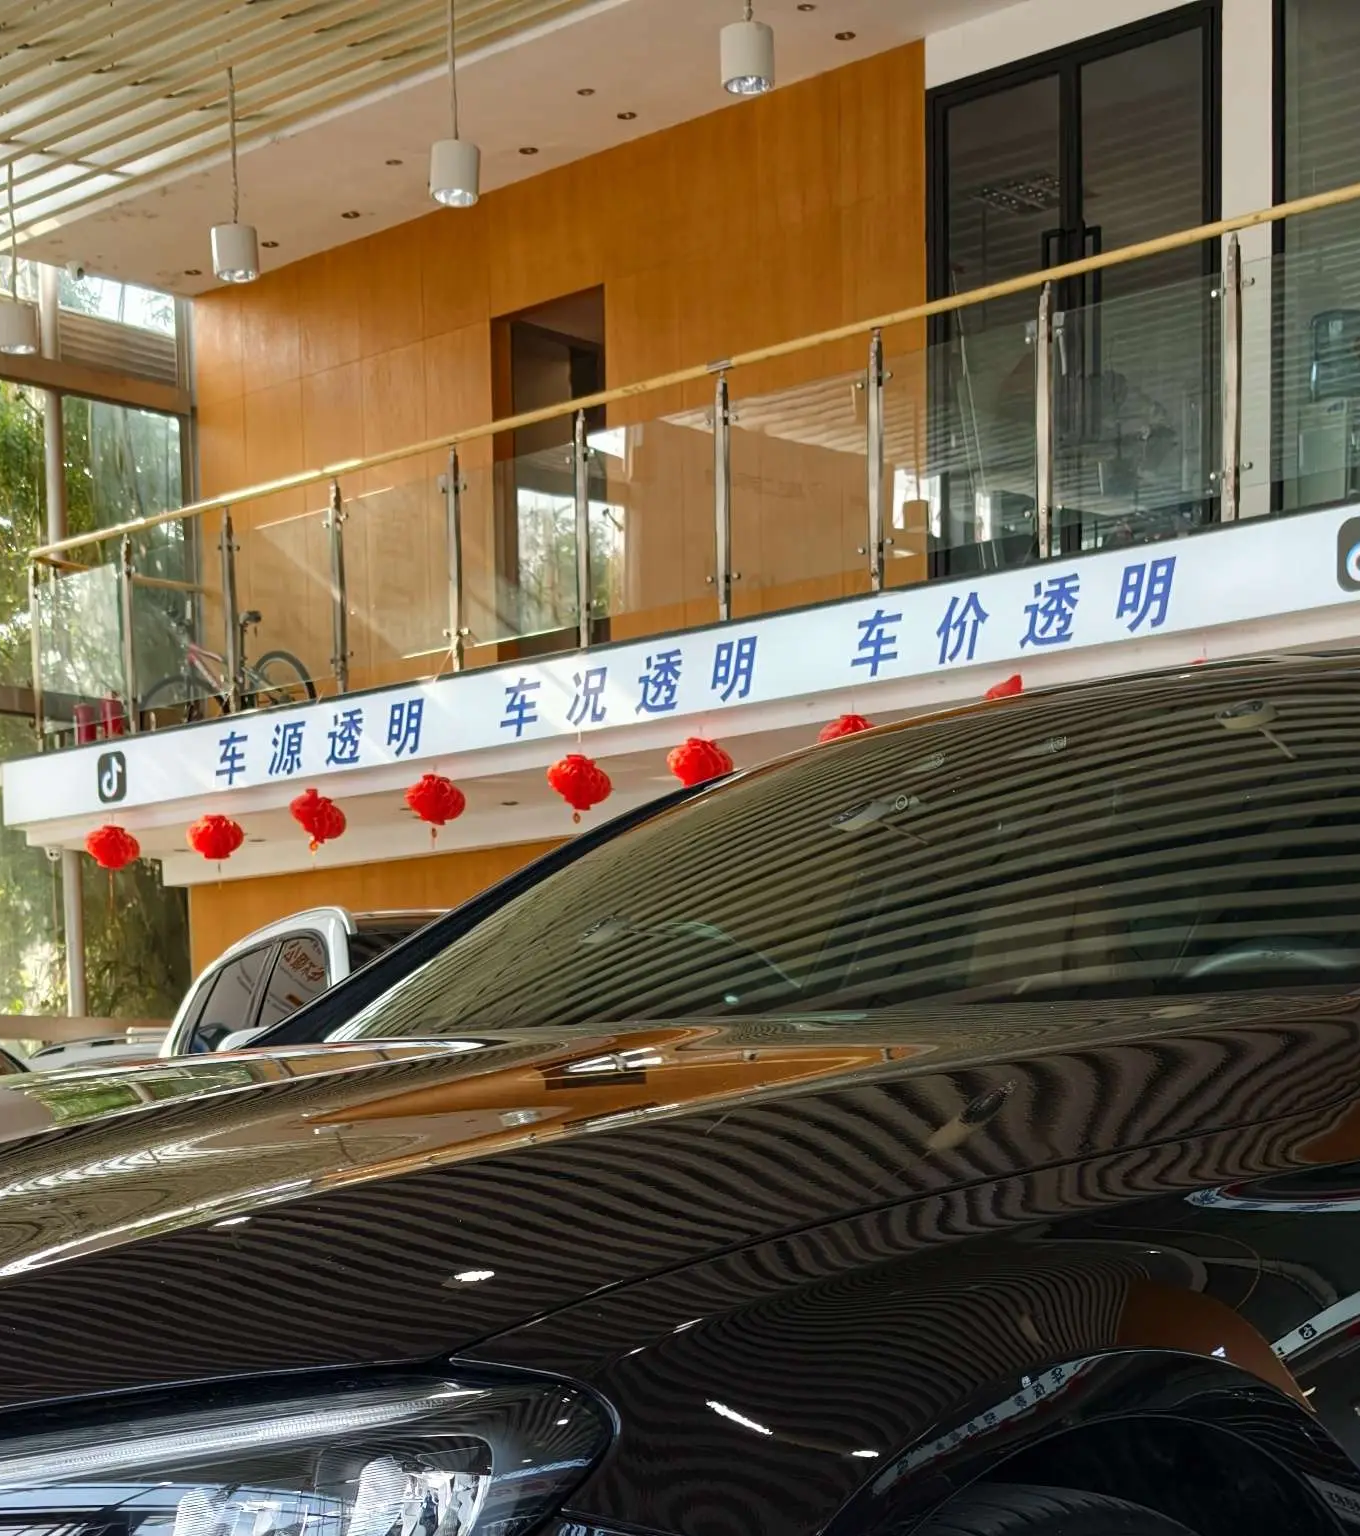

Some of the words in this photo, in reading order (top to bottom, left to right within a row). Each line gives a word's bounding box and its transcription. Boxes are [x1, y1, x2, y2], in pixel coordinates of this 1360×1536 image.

[850, 556, 1177, 677] 车价透明
[499, 635, 758, 738] 车况透明
[215, 699, 425, 787] 车源透明
